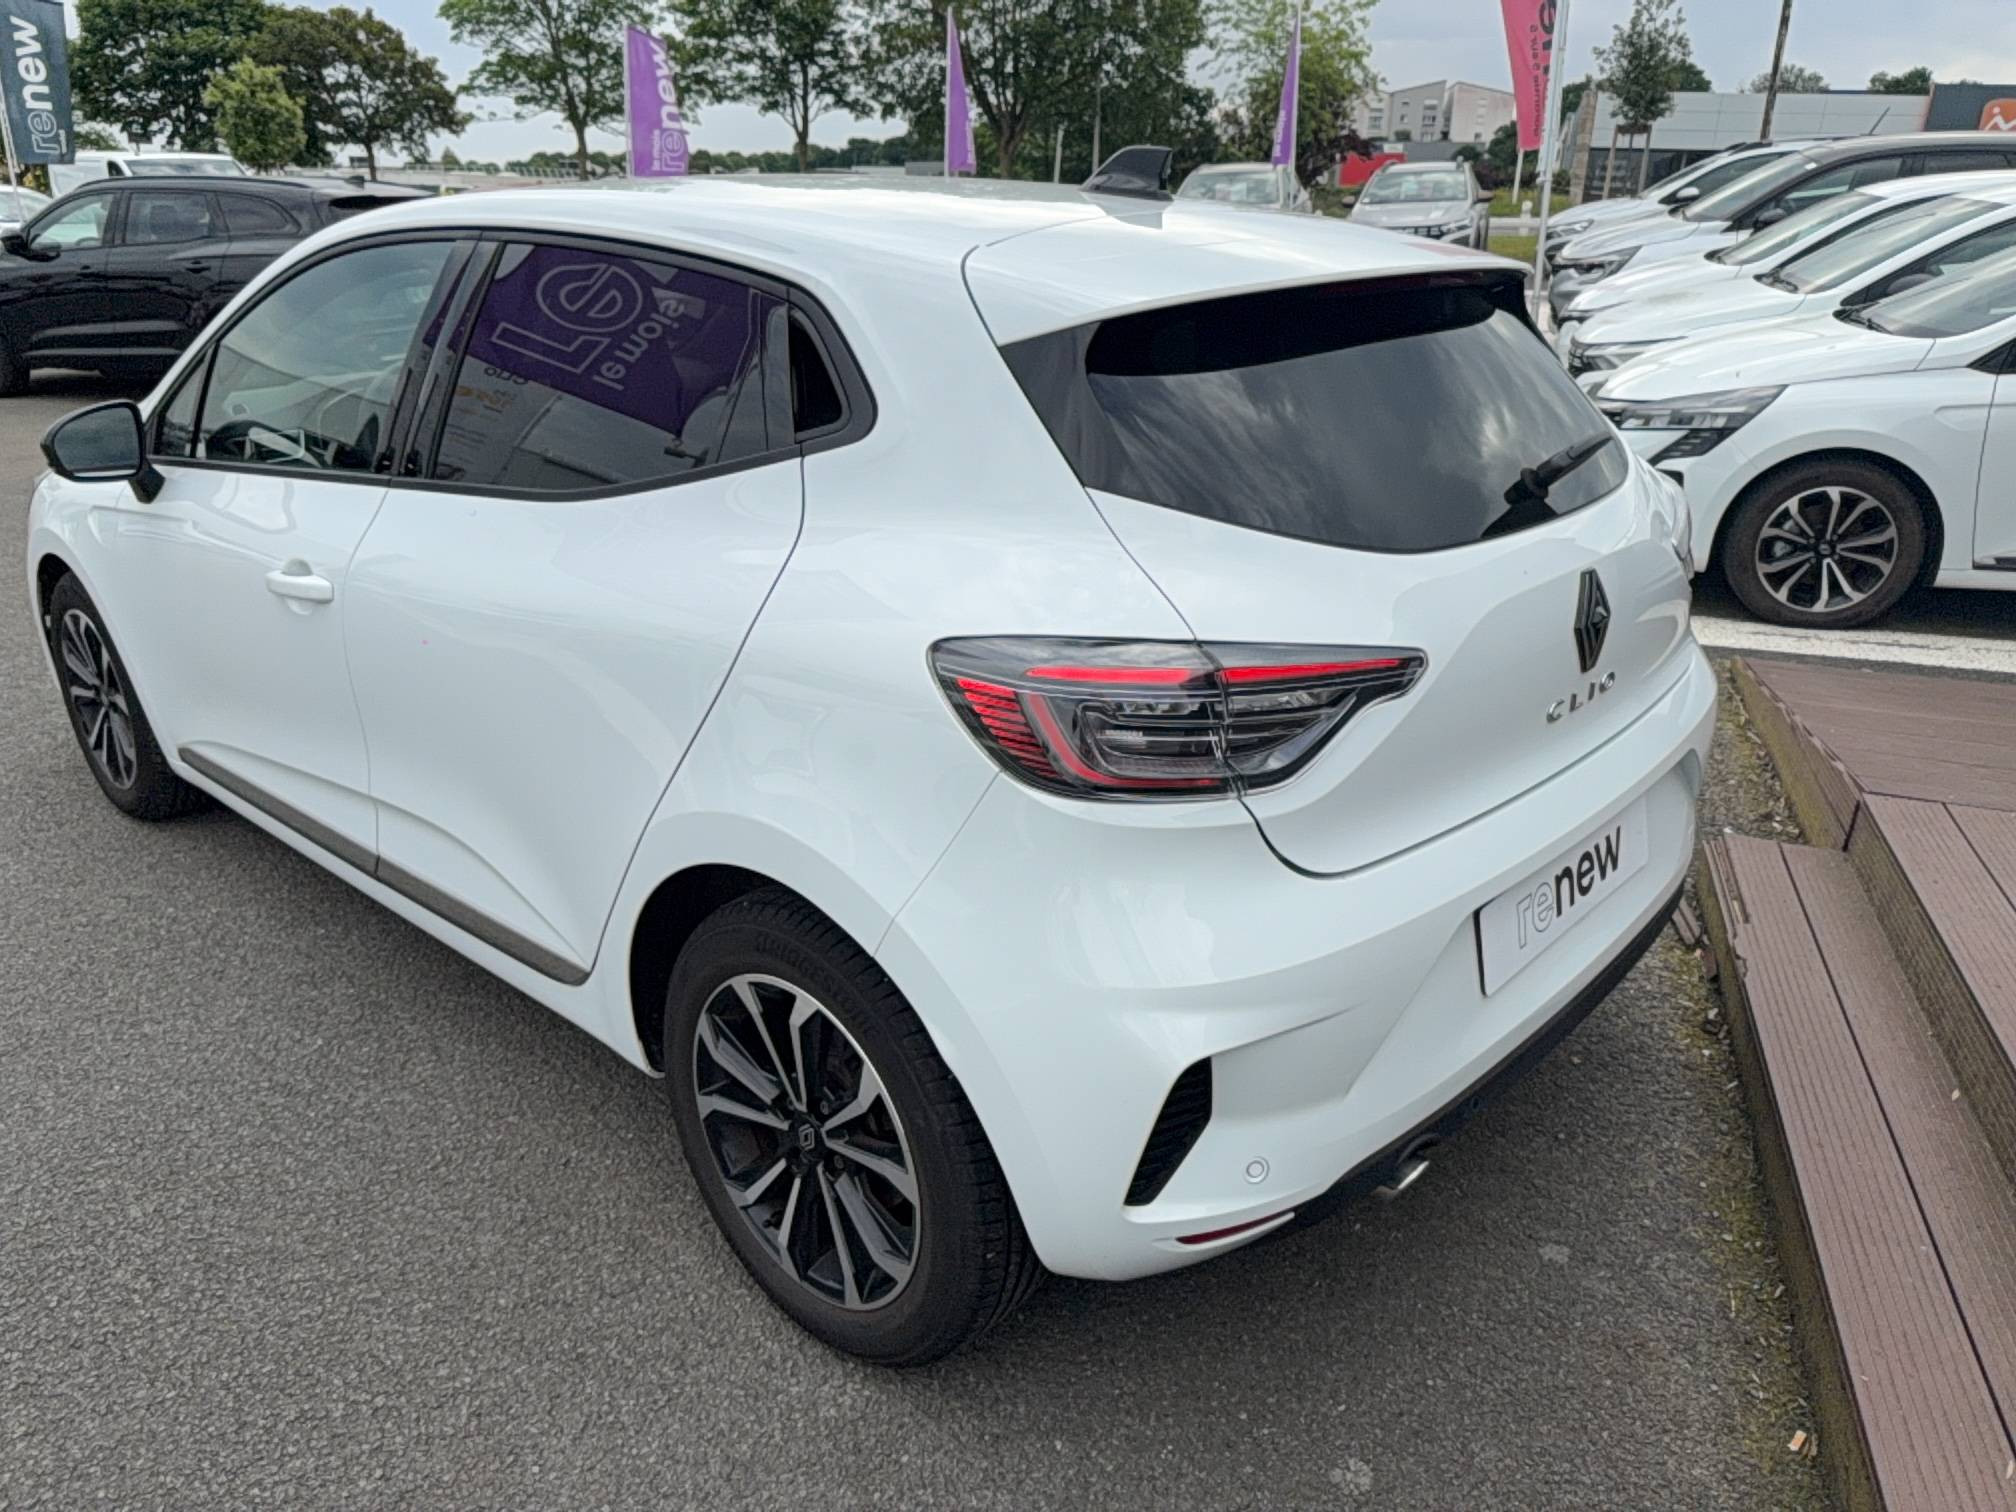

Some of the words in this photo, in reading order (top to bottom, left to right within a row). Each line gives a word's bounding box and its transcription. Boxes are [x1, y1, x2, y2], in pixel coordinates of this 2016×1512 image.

[9, 15, 58, 154] renew
[648, 37, 685, 171] renew
[1546, 671, 1616, 724] CLIO
[1515, 825, 1622, 950] renew
